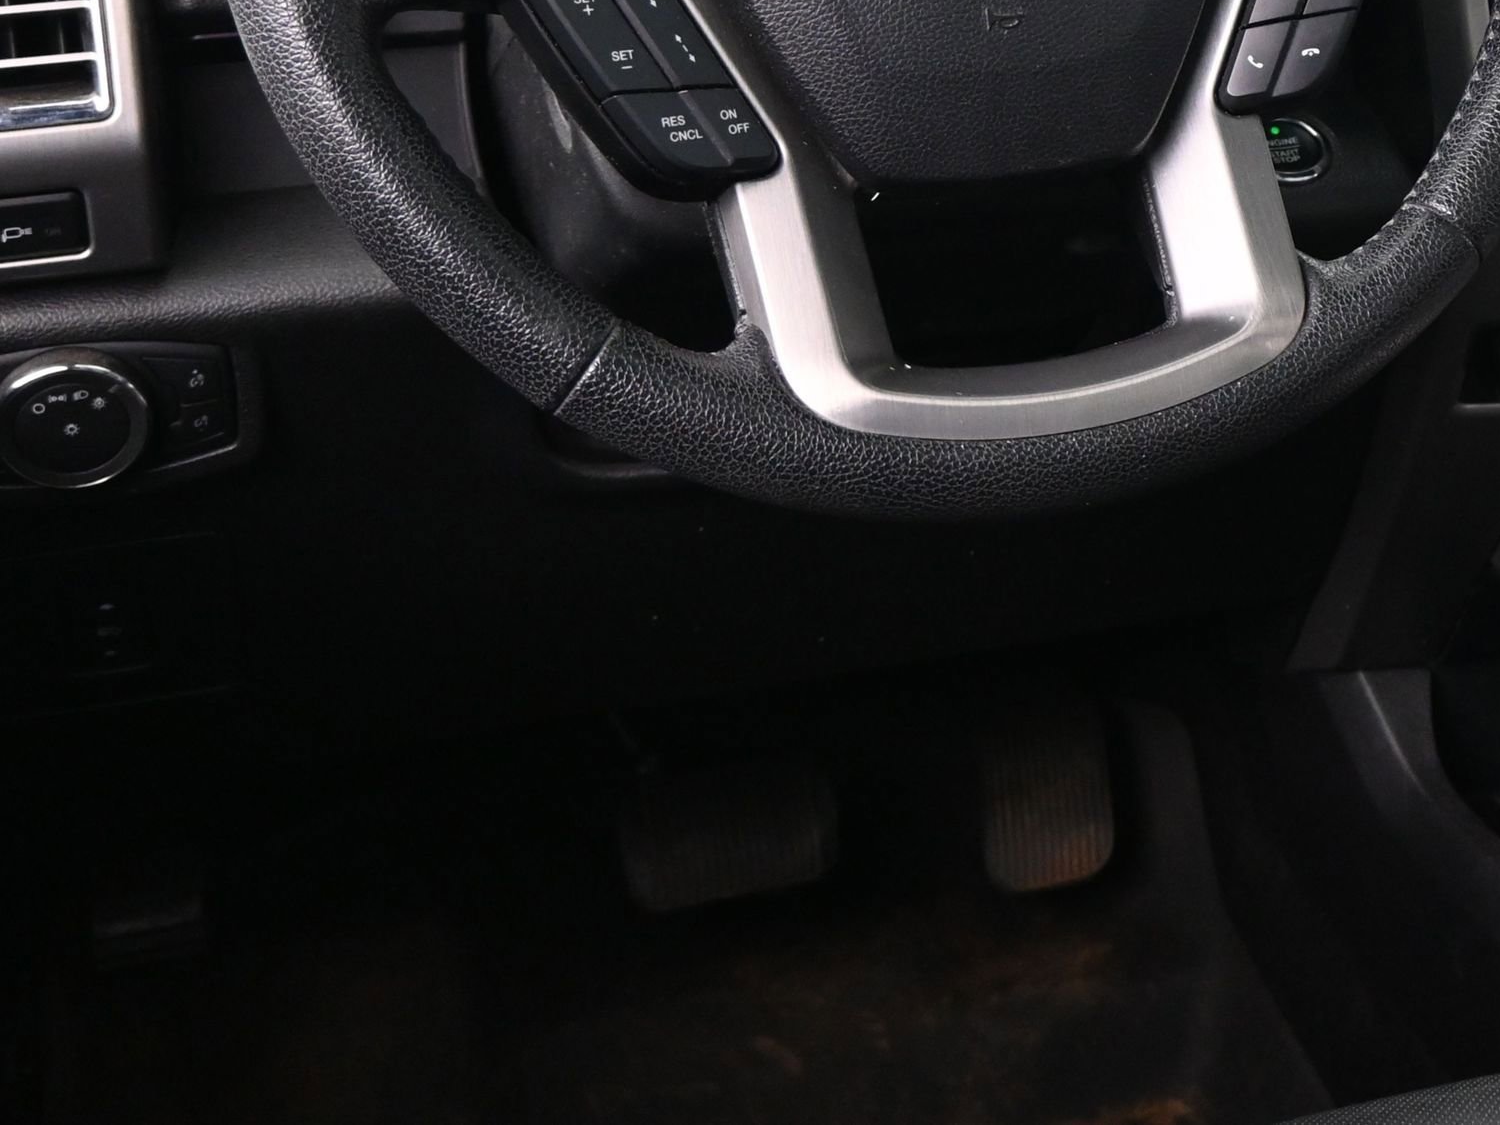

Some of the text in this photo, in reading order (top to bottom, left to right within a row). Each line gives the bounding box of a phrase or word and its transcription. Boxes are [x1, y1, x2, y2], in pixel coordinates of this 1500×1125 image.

[611, 49, 634, 62] SET
[661, 115, 686, 127] RES
[720, 108, 738, 121] ON
[728, 122, 750, 135] OFF
[670, 129, 703, 143] CNCL
